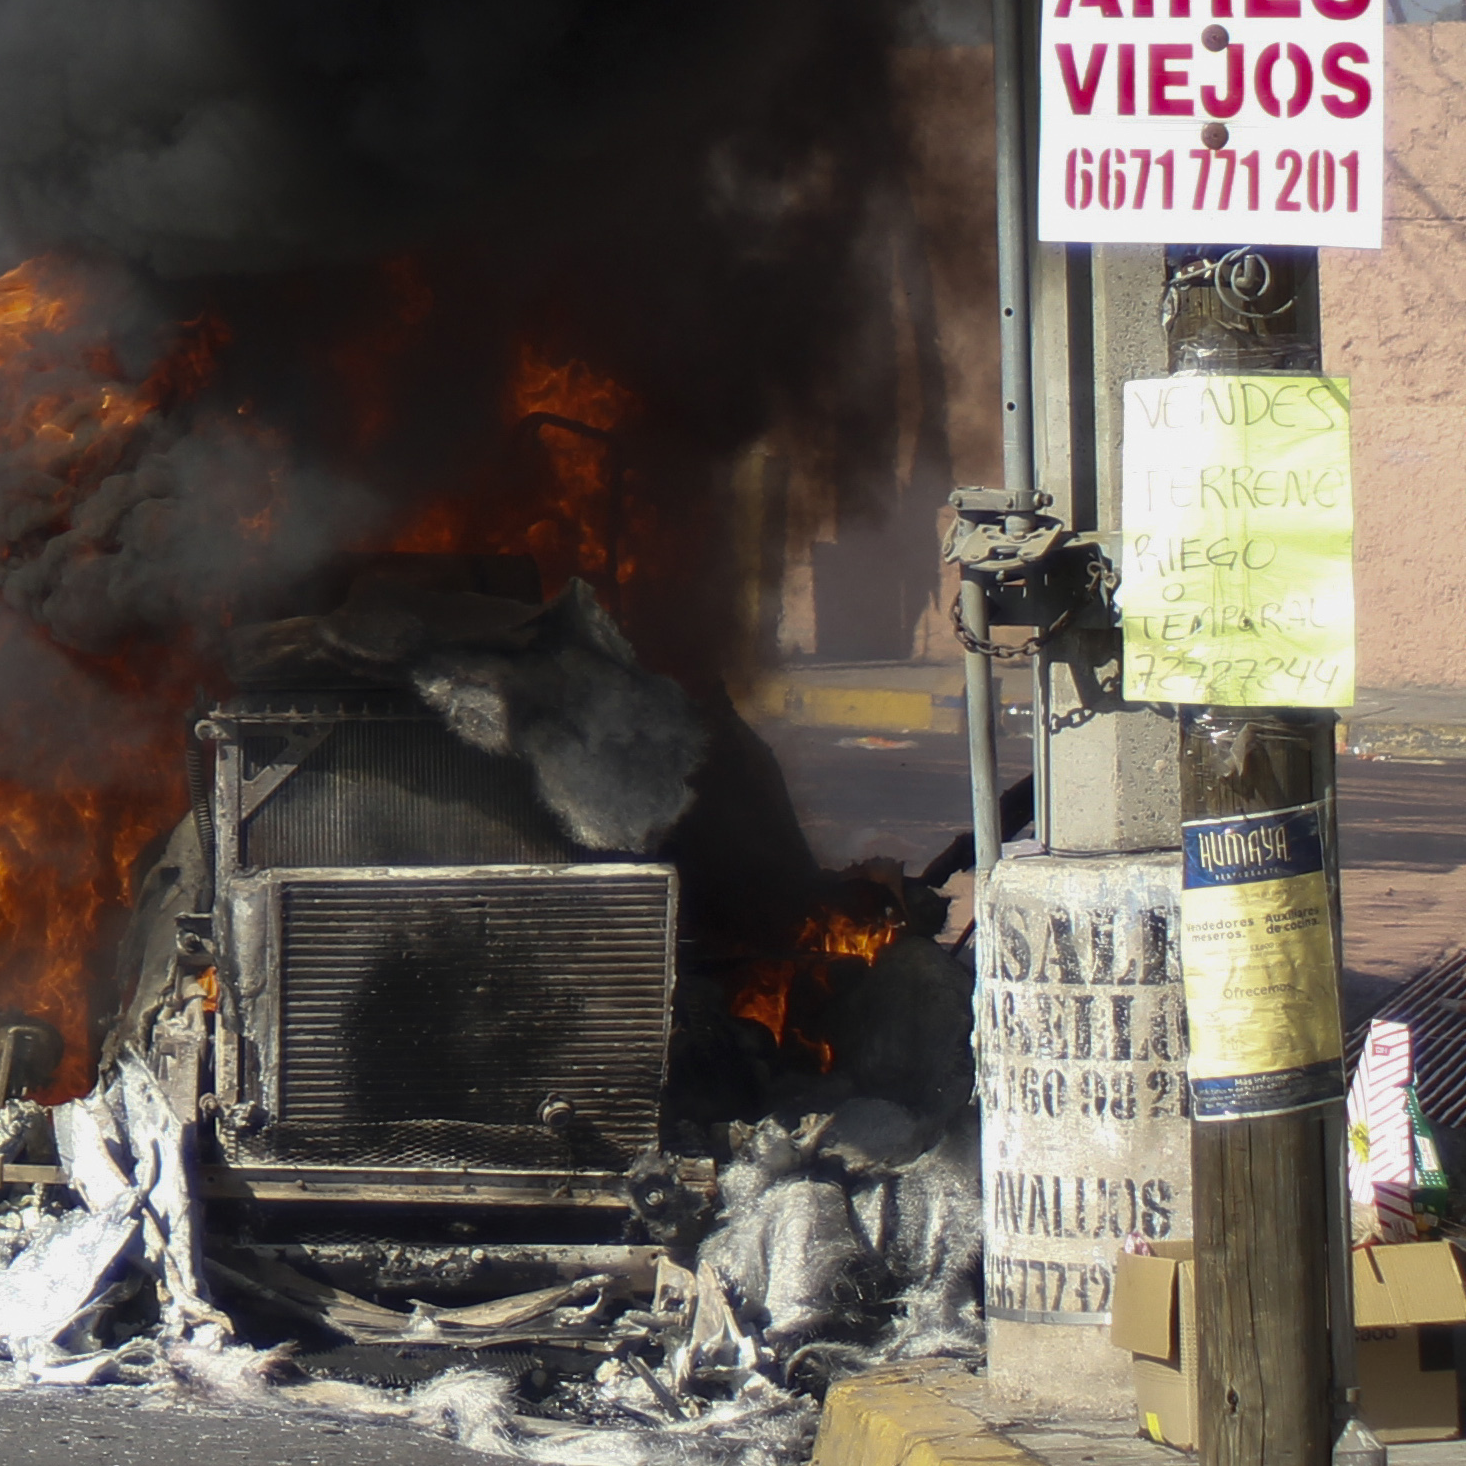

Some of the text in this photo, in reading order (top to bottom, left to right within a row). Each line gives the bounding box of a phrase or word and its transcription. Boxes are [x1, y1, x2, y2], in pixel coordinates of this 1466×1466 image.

[1054, 41, 1372, 119] VIEJOS
[1135, 535, 1276, 577] RIEGO
[1126, 598, 1325, 641] TEMPORAL
[1199, 825, 1288, 872] HUMAYA
[1186, 917, 1254, 933] Vendedores
[1265, 907, 1319, 925] Auxiliares
[1266, 923, 1281, 935] de
